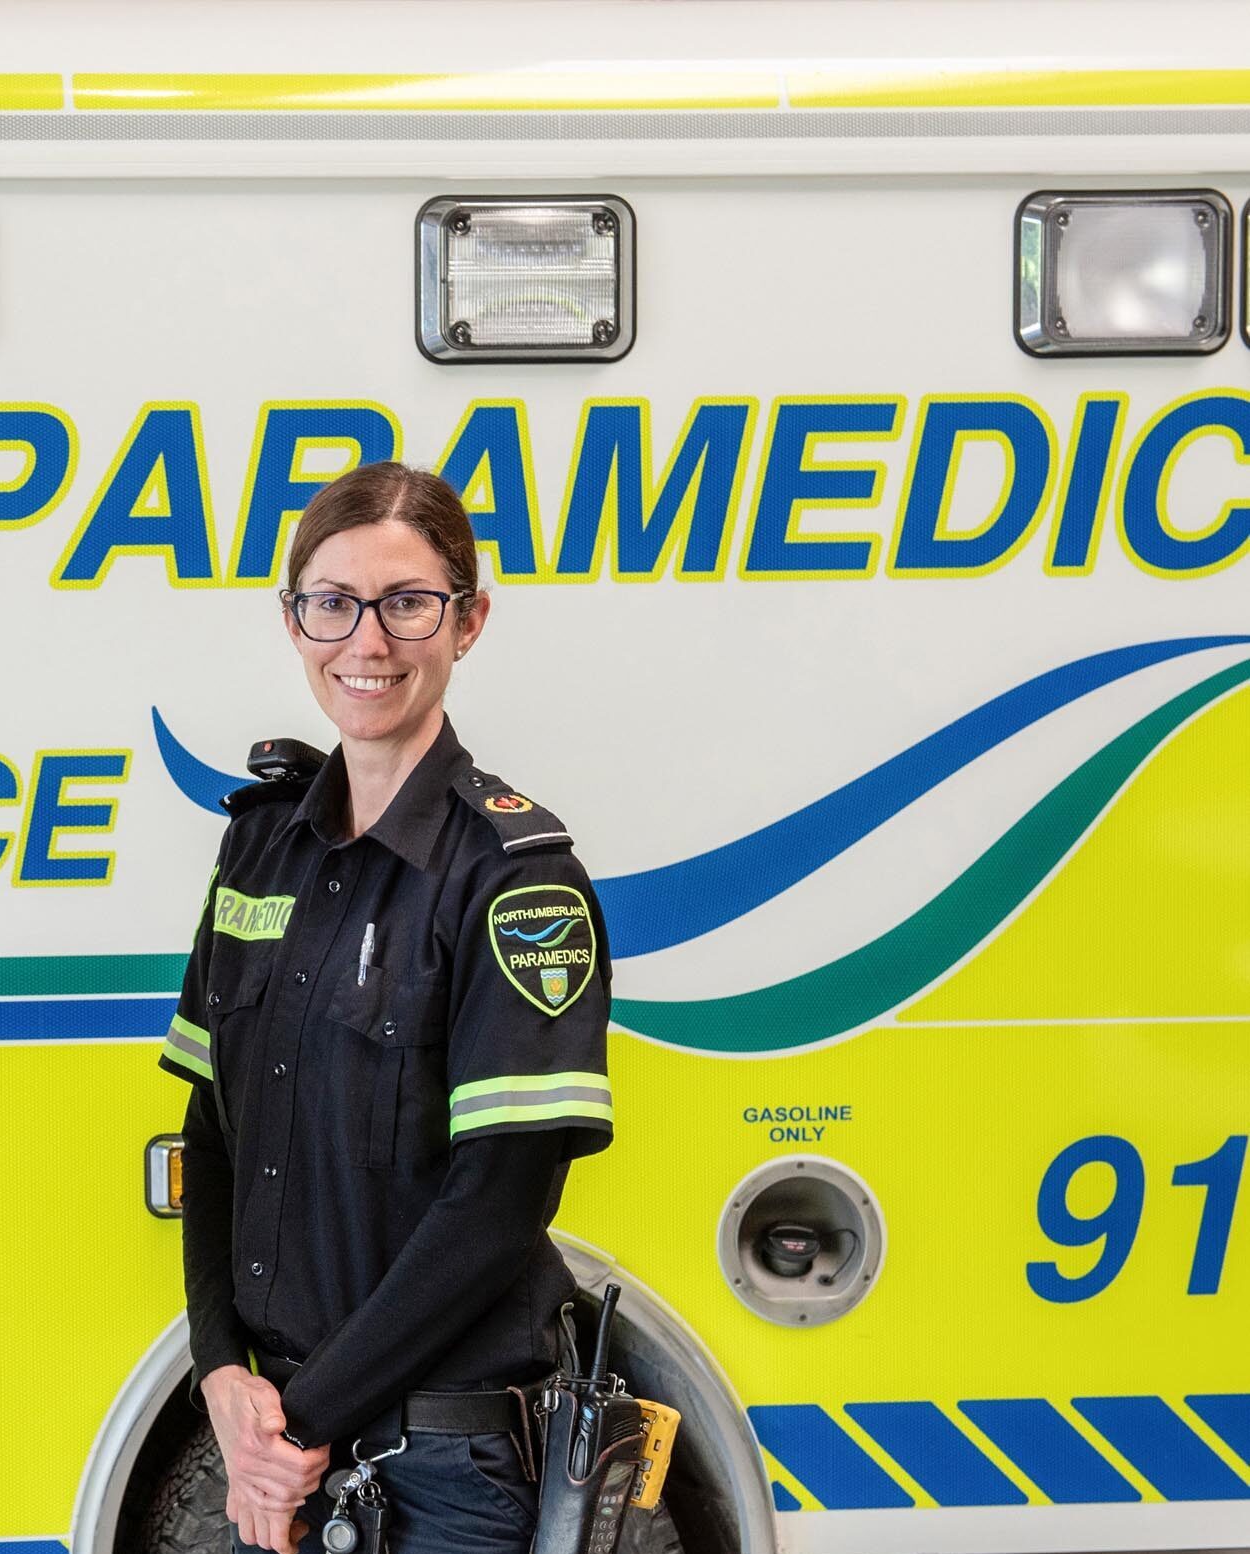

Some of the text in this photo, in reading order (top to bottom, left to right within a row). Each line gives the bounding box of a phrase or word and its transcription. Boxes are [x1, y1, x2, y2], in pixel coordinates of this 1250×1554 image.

[493, 906, 586, 925] NORTHUMBERLAND
[510, 949, 590, 969] PARAMEDICS
[743, 1105, 852, 1123] GASOLINE
[769, 1126, 825, 1142] ONLY
[1025, 1134, 1249, 1304] 91
